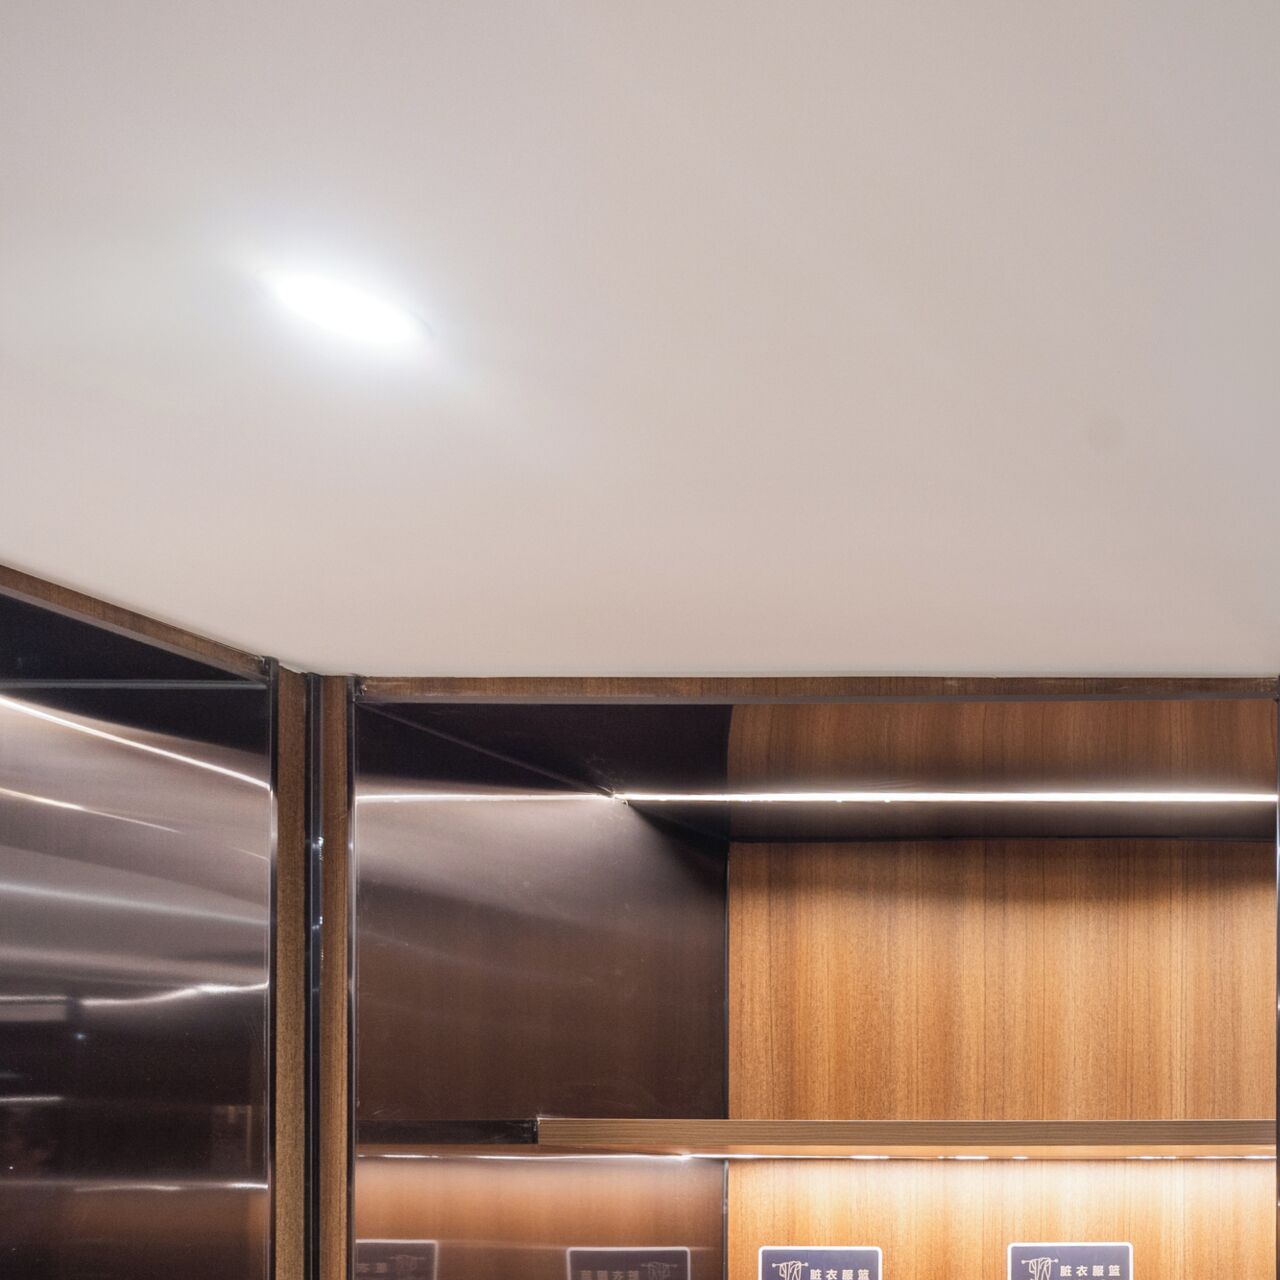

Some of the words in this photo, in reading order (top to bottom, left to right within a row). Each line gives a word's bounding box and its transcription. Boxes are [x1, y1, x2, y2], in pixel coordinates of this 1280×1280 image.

[810, 1269, 870, 1280] 脏衣服篮
[1060, 1265, 1120, 1277] 脏衣服篮
